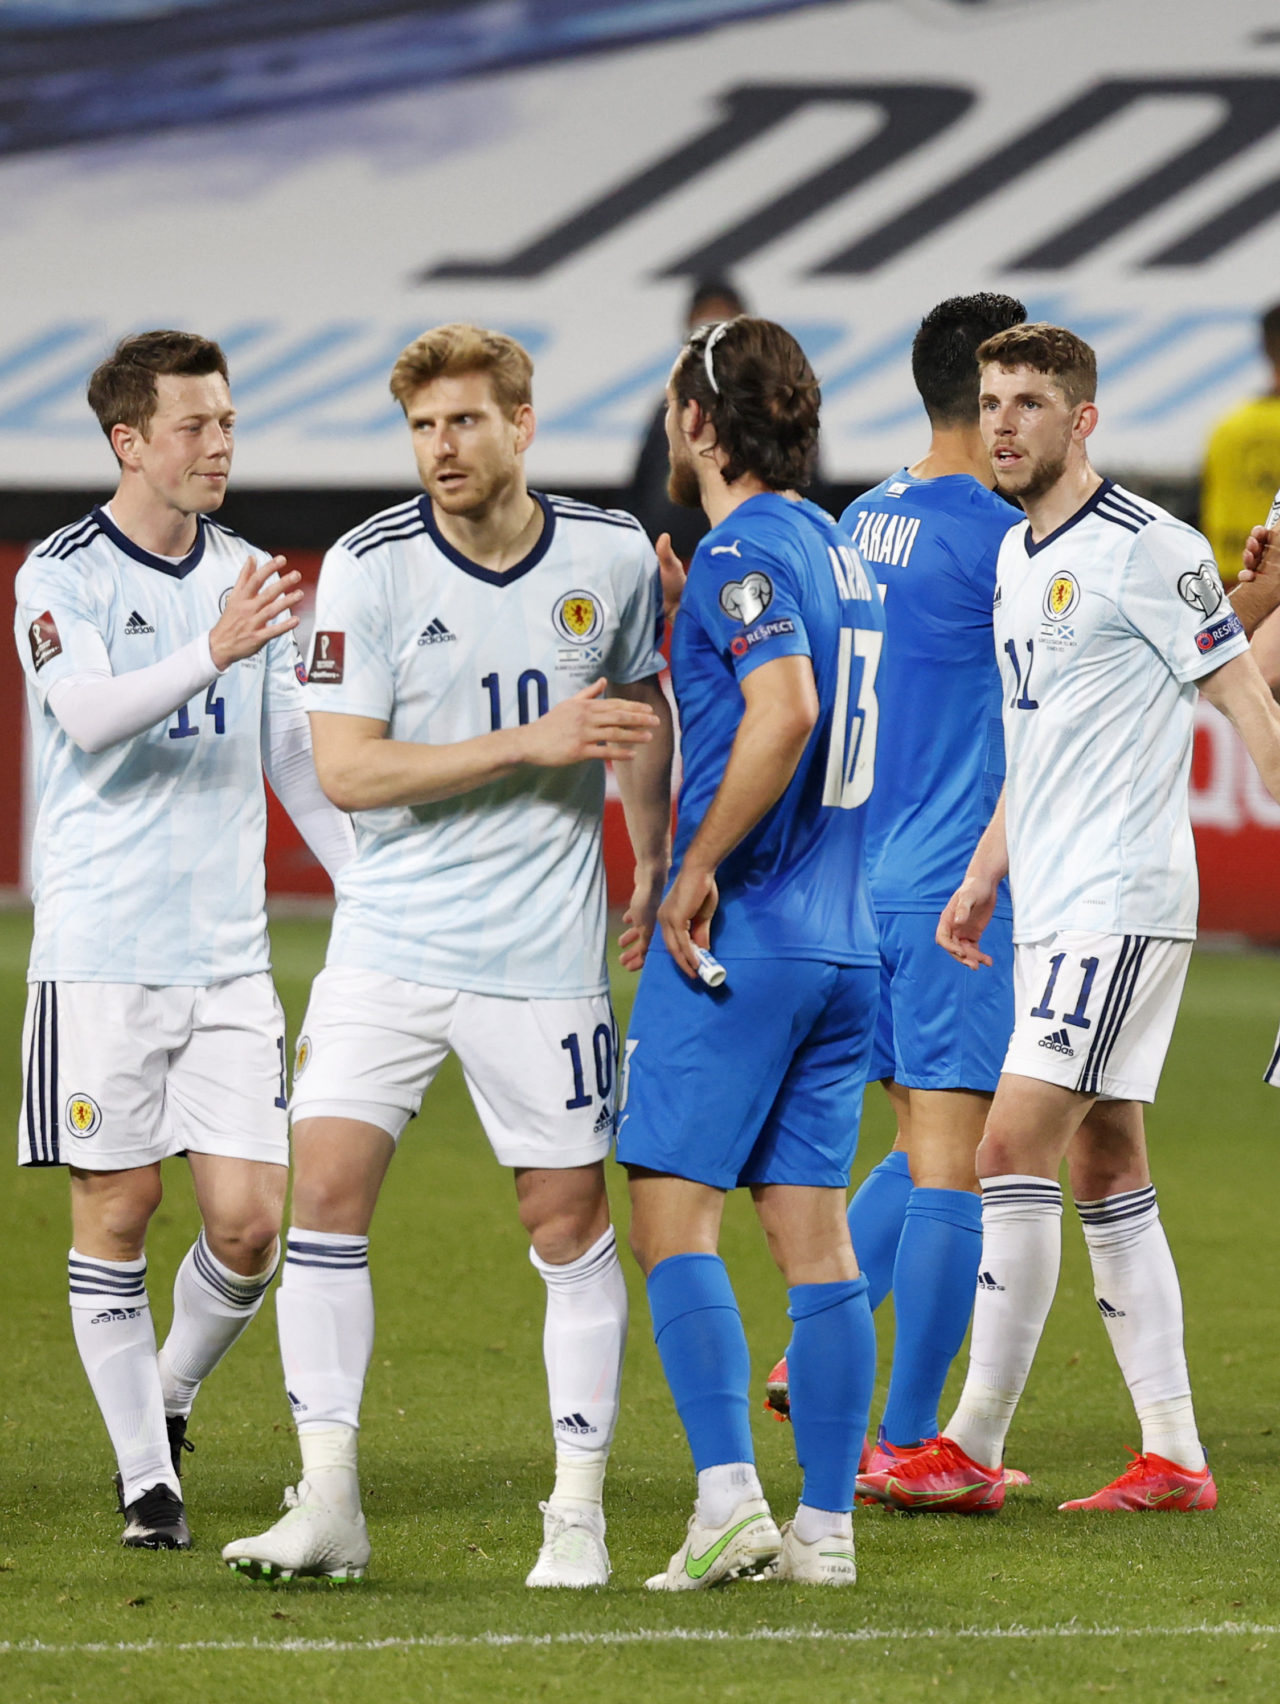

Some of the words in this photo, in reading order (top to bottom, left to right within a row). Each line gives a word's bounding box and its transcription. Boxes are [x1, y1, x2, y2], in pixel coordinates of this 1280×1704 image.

[852, 510, 921, 568] ZAHAVI
[125, 625, 155, 635] adidas
[417, 632, 456, 646] adidas
[746, 620, 794, 645] RESPECT
[481, 668, 549, 732] 10
[1004, 638, 1039, 710] 11
[822, 627, 883, 809] 13
[1030, 952, 1100, 1029] 11
[561, 1023, 612, 1110] 10
[1038, 1038, 1074, 1057] adidas
[91, 1311, 141, 1324] adidas
